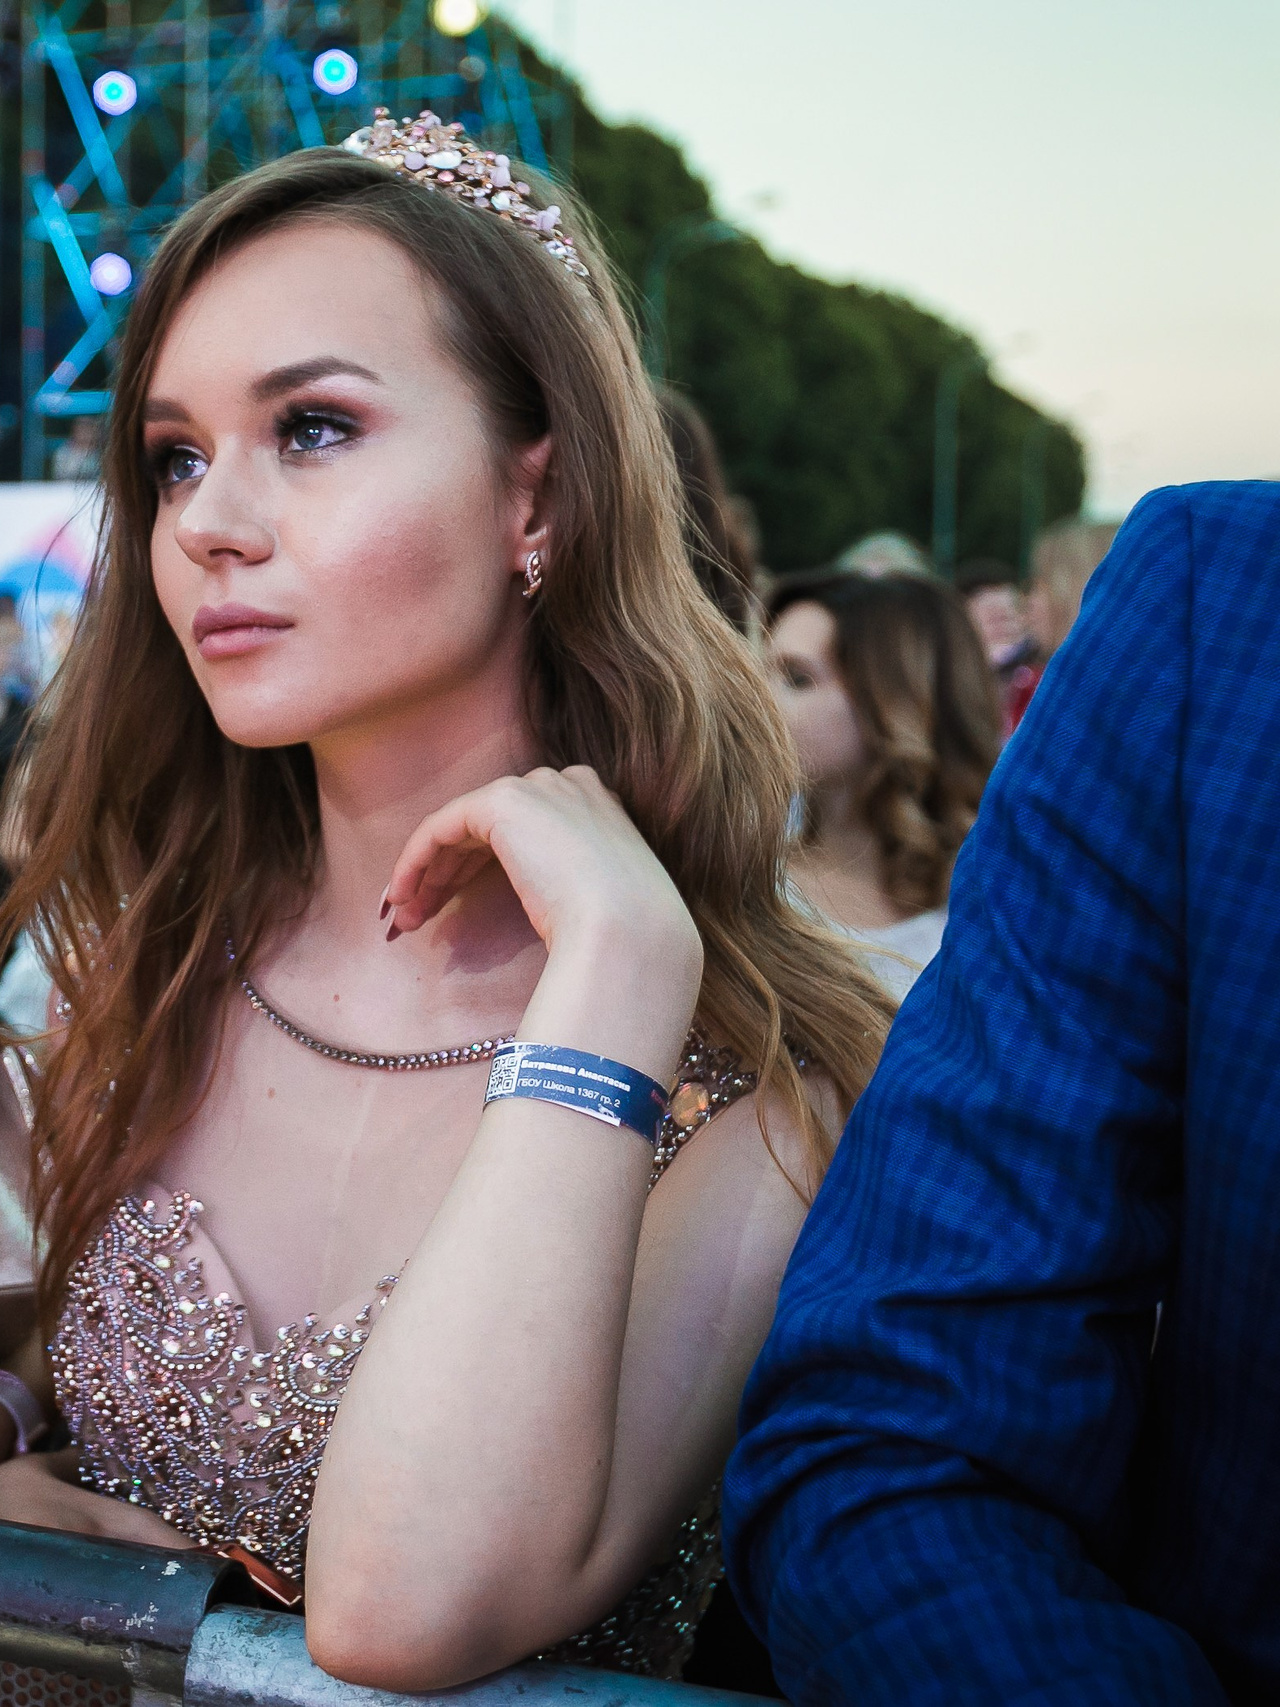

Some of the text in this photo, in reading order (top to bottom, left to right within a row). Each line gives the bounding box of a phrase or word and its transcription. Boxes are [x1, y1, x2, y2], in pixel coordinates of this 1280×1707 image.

[517, 1078, 542, 1088] ГБОУ
[543, 1079, 575, 1095] Школа
[614, 1099, 621, 1108] 2
[577, 1067, 631, 1092] Анастасия
